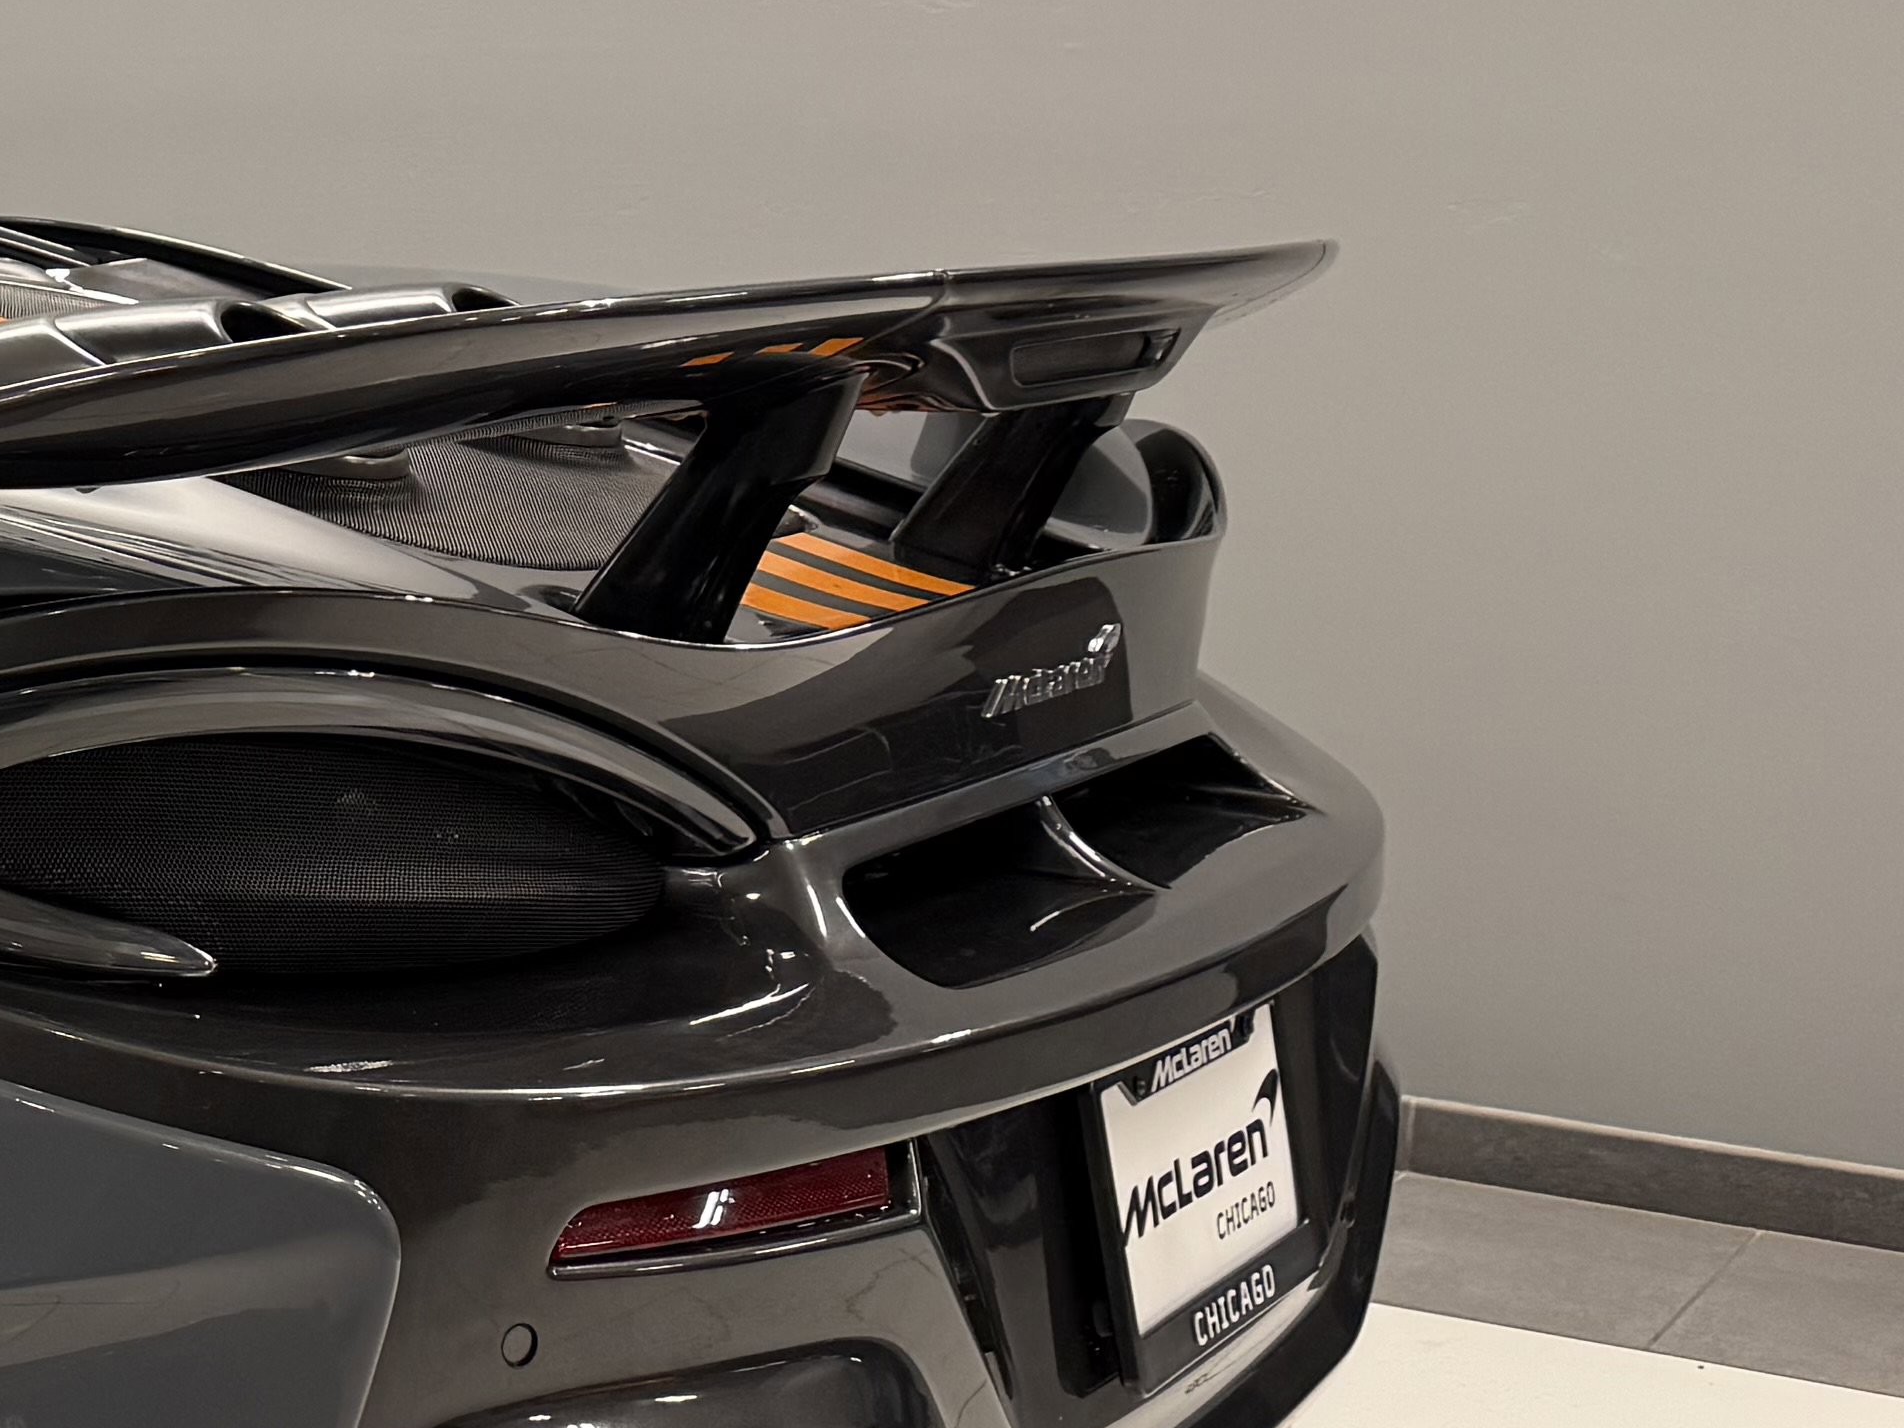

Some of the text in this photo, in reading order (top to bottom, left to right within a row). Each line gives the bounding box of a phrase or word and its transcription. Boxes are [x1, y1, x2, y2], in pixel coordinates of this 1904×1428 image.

[1150, 1026, 1232, 1094] McLaren
[1123, 1117, 1269, 1249] McLaren
[1216, 1180, 1277, 1241] CHICAGO
[1194, 1264, 1276, 1347] CHICAGO
